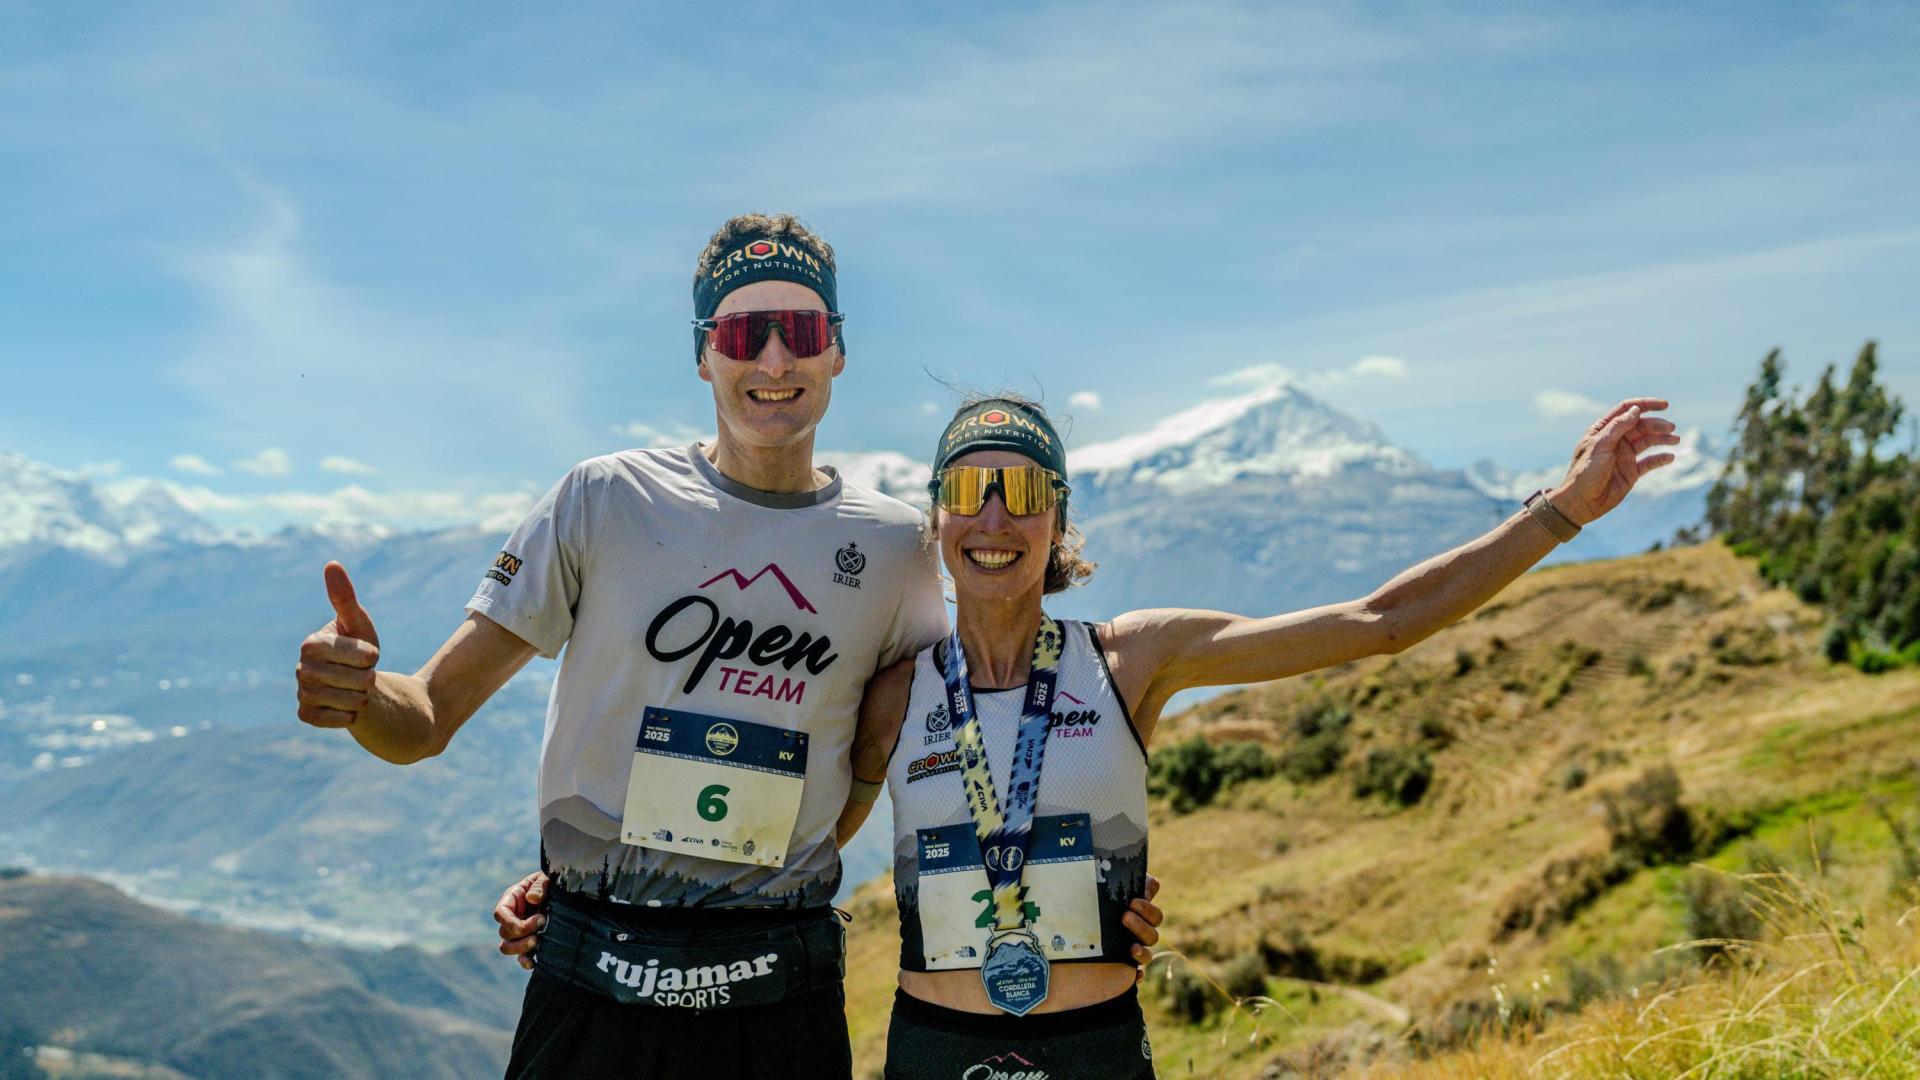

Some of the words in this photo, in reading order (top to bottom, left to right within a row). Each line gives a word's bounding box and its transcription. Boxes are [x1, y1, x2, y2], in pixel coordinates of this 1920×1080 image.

[712, 239, 821, 278] CROWN
[714, 265, 749, 292] SPORT
[754, 261, 823, 284] NUTRITION
[948, 409, 1051, 445] CROWN
[946, 430, 978, 453] SPORT
[984, 428, 1051, 456] NUTRITION
[833, 572, 861, 590] IRIER
[645, 595, 838, 695] Open
[718, 666, 806, 705] TEAM
[1036, 682, 1049, 707] 2025
[954, 690, 965, 715] 2025
[644, 730, 670, 742] 2025
[923, 731, 952, 746] IRIER
[1056, 727, 1093, 738] TEAM
[779, 751, 795, 761] KV
[697, 784, 730, 822] 6
[977, 791, 988, 812] CIVA
[689, 837, 704, 845] CIVA
[925, 847, 950, 859] 2025
[1060, 836, 1076, 847] KV
[596, 951, 778, 997] rujamar
[654, 985, 731, 1009] SPORTS
